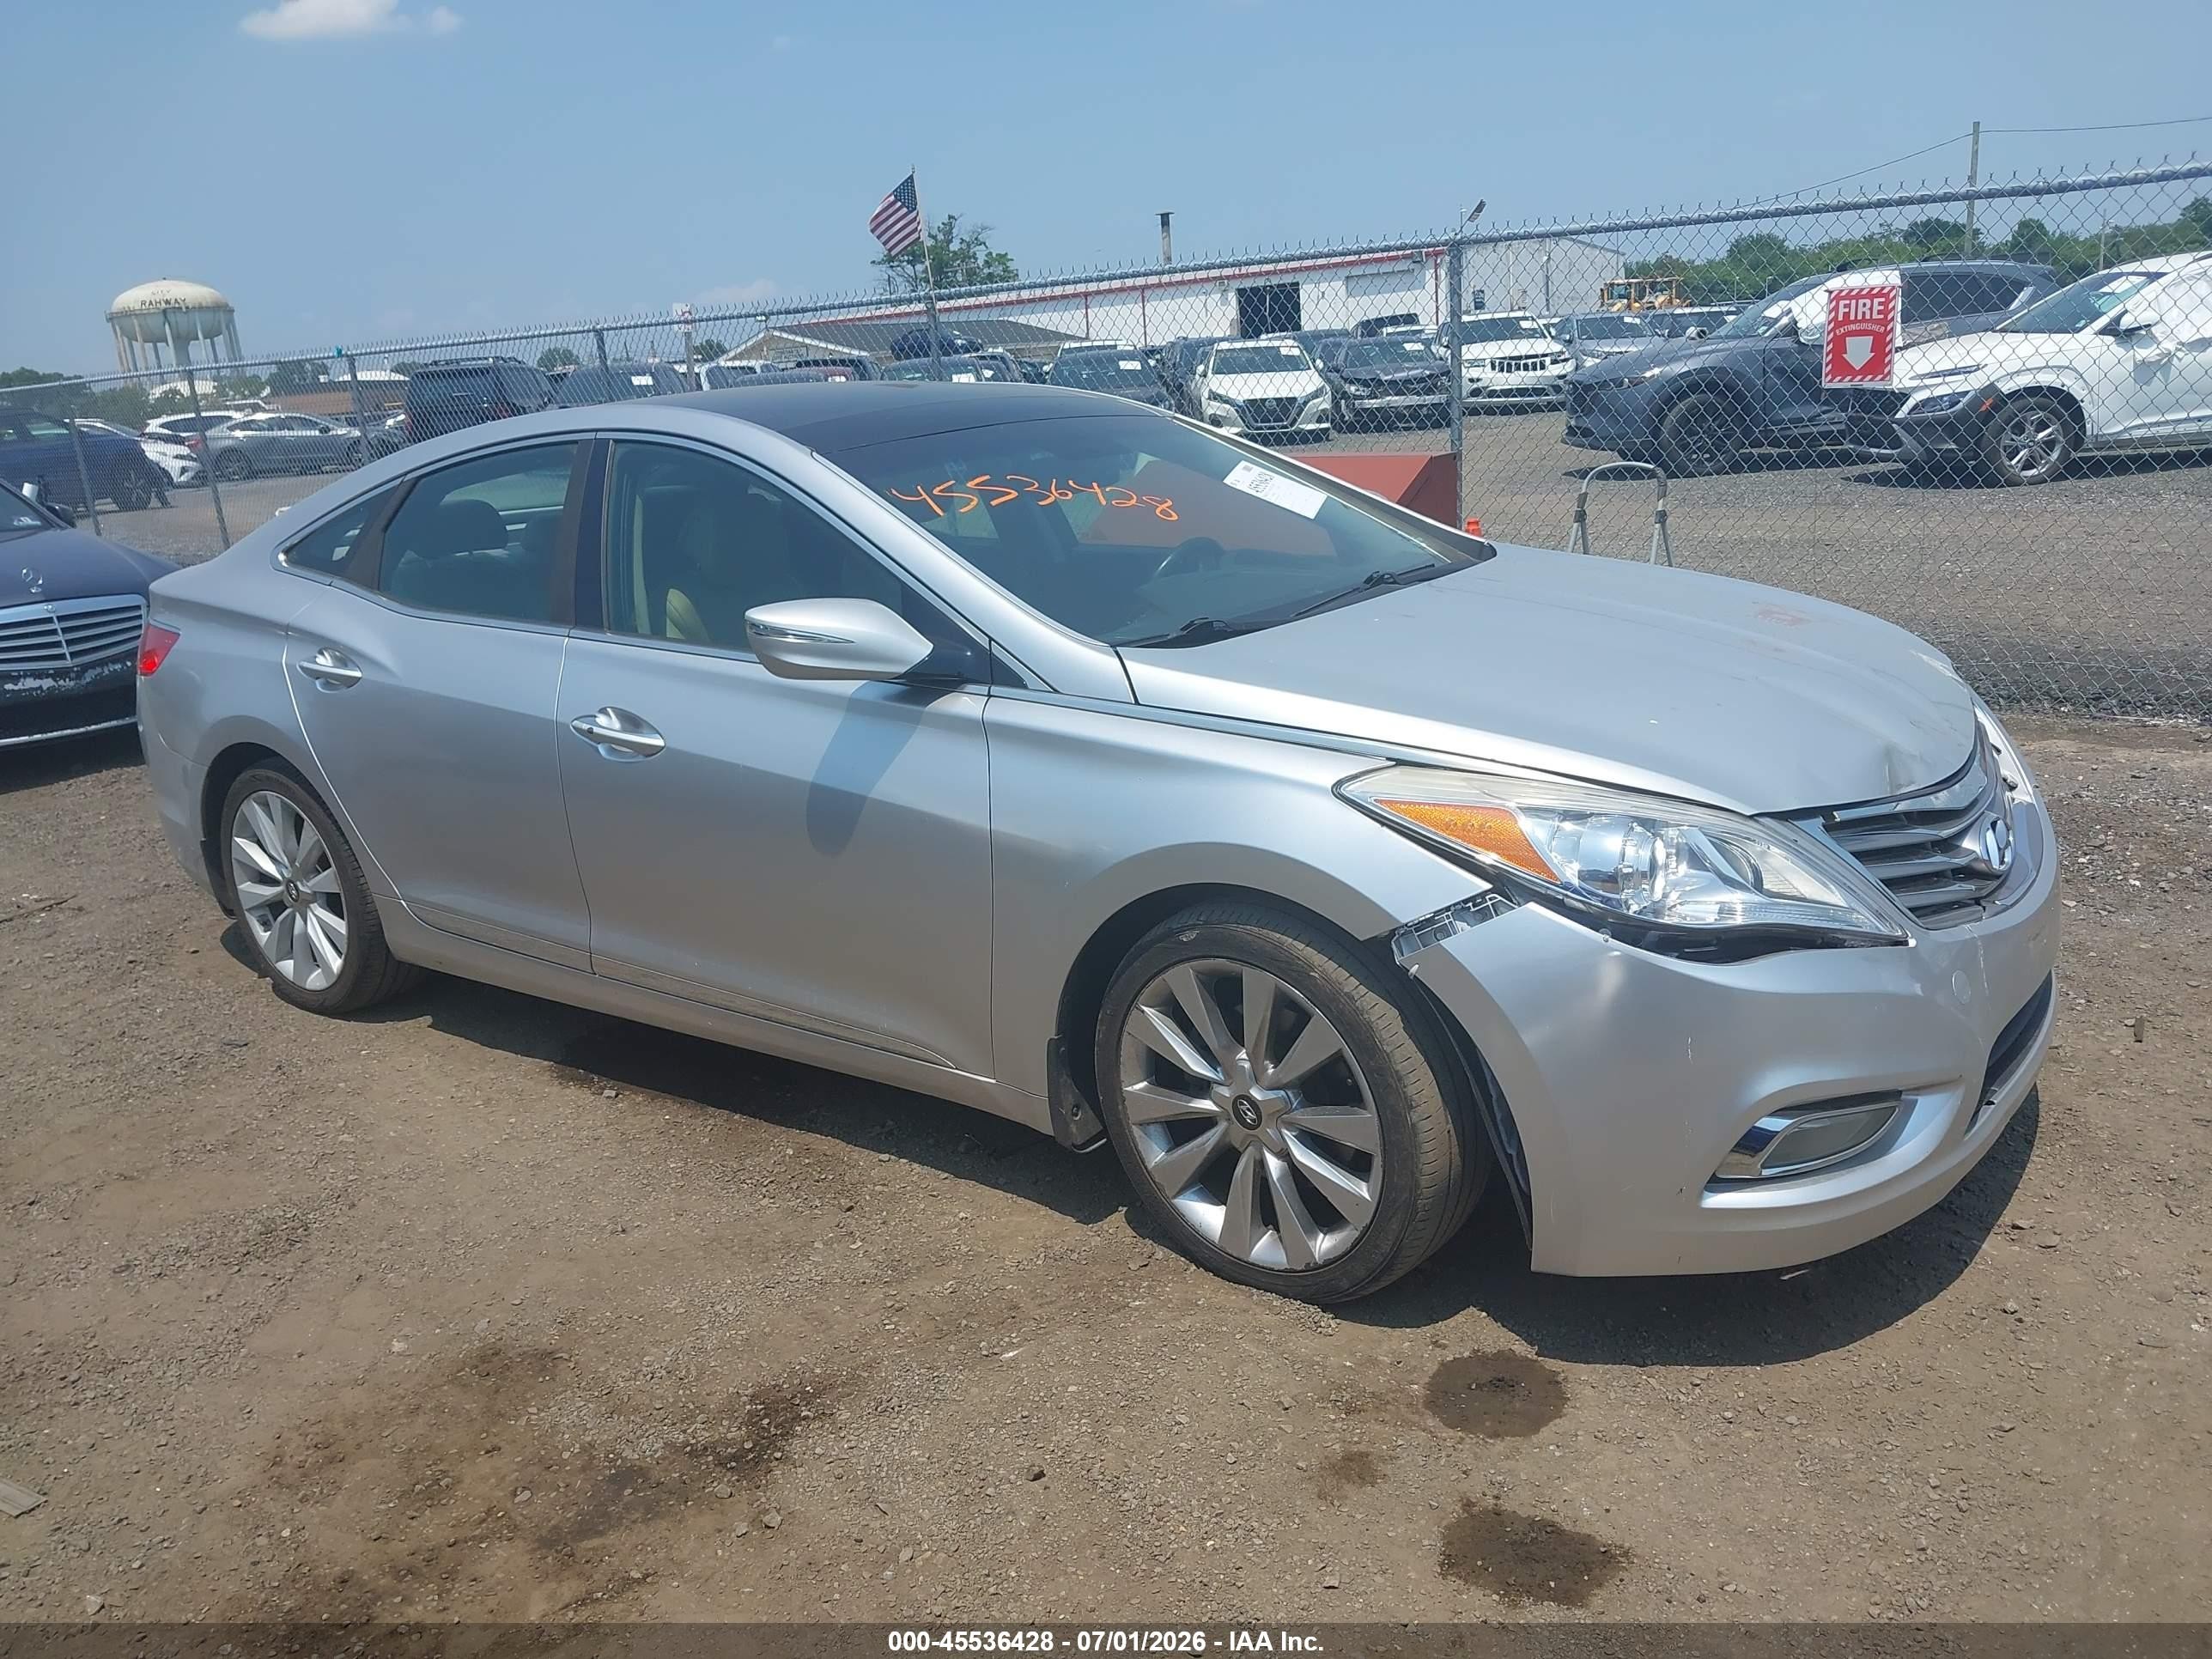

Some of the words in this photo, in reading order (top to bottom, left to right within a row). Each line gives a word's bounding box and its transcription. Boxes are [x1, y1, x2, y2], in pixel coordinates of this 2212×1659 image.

[140, 297, 186, 308] RAHWAY
[1838, 297, 1886, 321] FIRE
[1835, 322, 1886, 336] EXTINGUISHER
[888, 474, 1179, 521] 45536428
